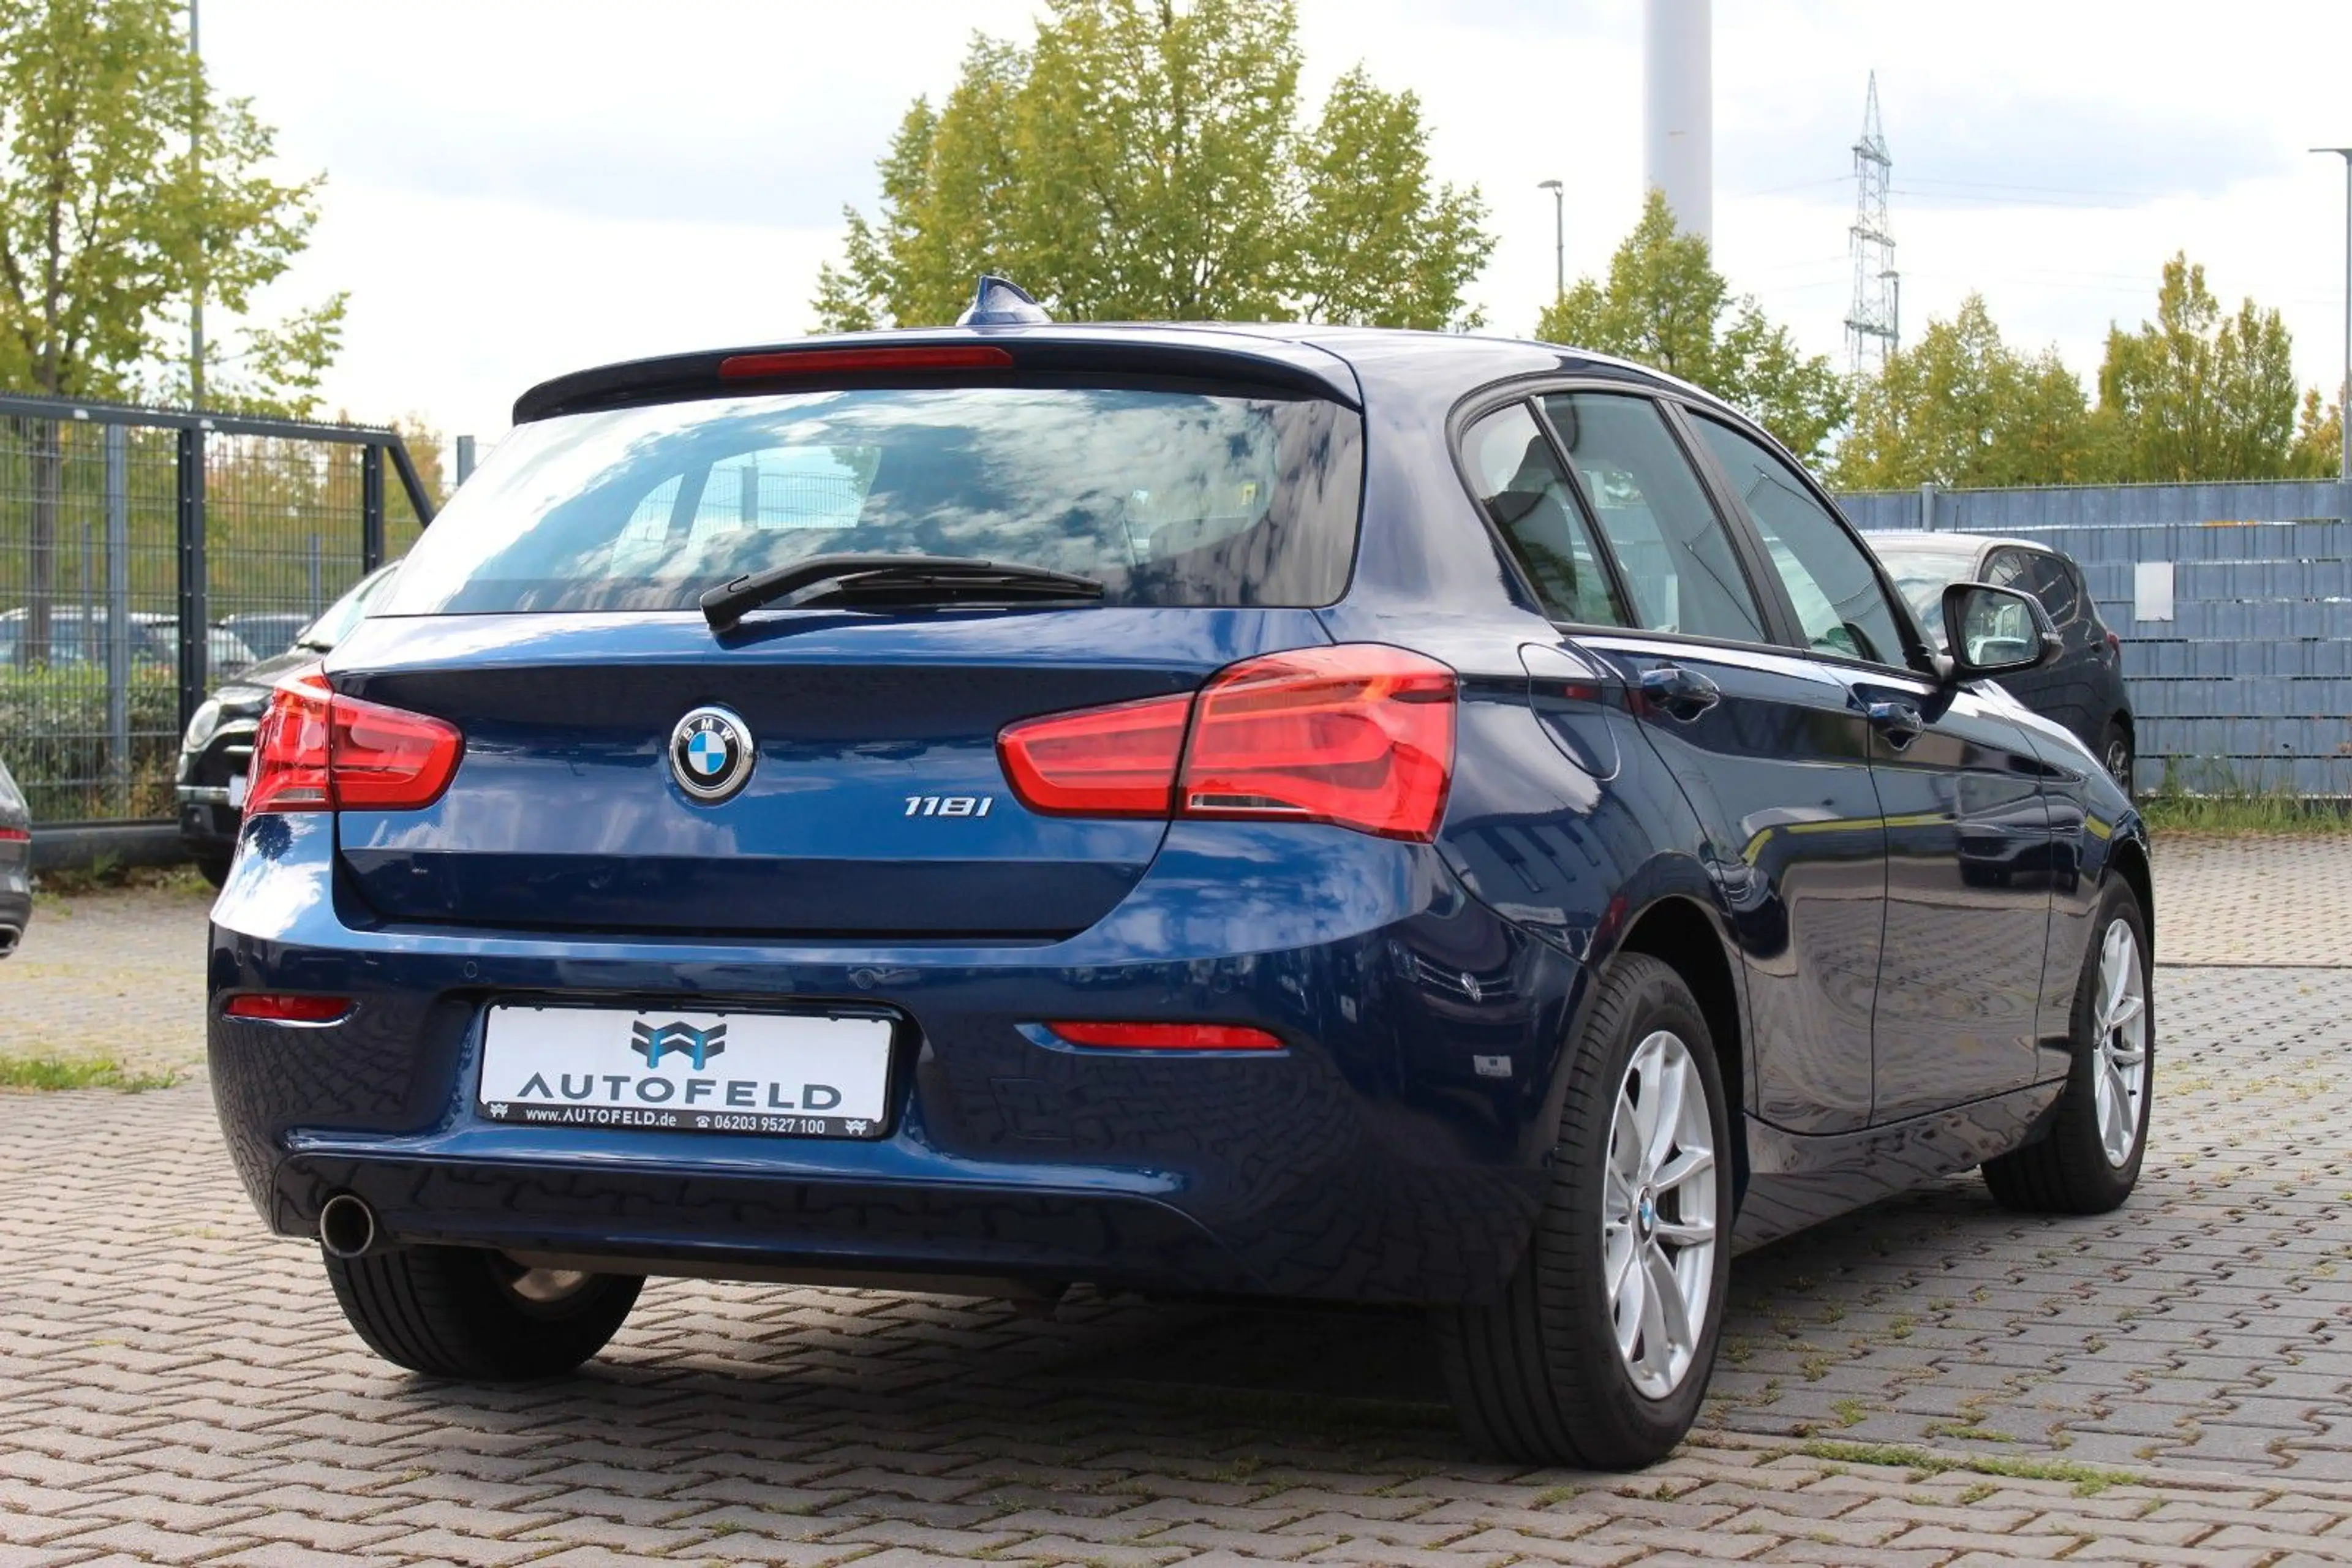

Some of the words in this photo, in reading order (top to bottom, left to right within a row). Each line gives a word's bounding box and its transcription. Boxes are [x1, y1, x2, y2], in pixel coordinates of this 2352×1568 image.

[682, 718, 736, 742] BMW
[517, 1071, 842, 1110] AUTOFELD
[526, 1108, 677, 1126] www.AUTOFELD.de
[714, 1114, 757, 1131] 06203
[761, 1117, 796, 1133] 9527
[801, 1120, 826, 1134] 100
